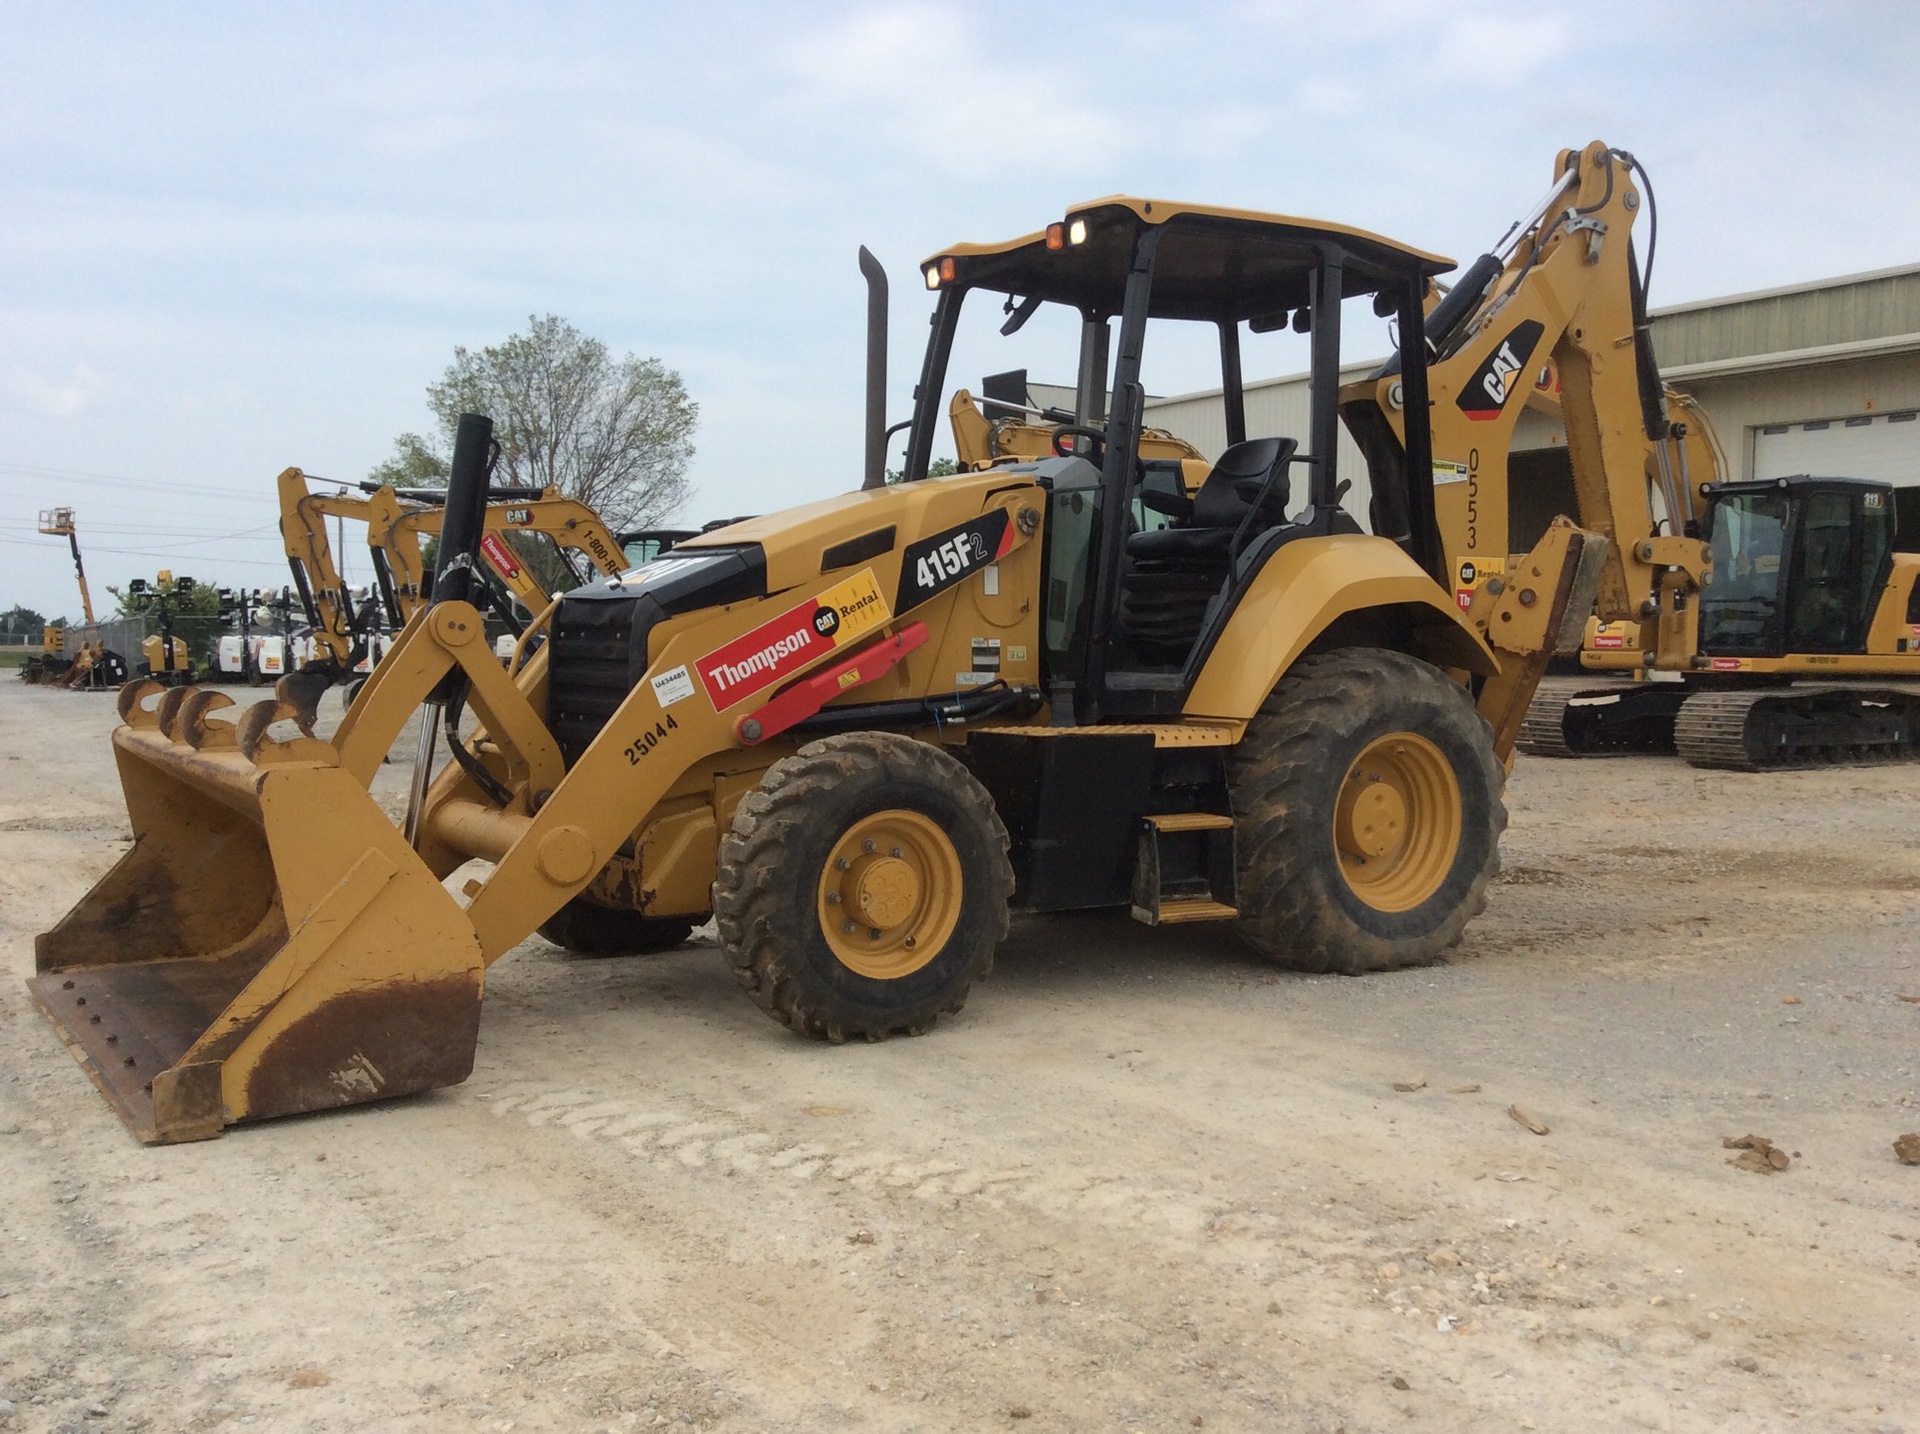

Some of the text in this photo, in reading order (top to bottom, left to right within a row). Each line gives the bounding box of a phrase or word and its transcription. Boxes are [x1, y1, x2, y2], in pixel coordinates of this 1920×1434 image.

[1483, 341, 1523, 404] CAT
[506, 509, 528, 524] CAT
[1467, 448, 1479, 549] 0553
[484, 538, 511, 571] Thompson
[708, 627, 812, 691] Thompson
[815, 611, 836, 632] CAT
[839, 589, 879, 618] Rental
[654, 670, 686, 689] U434485
[624, 713, 679, 766] 25044
